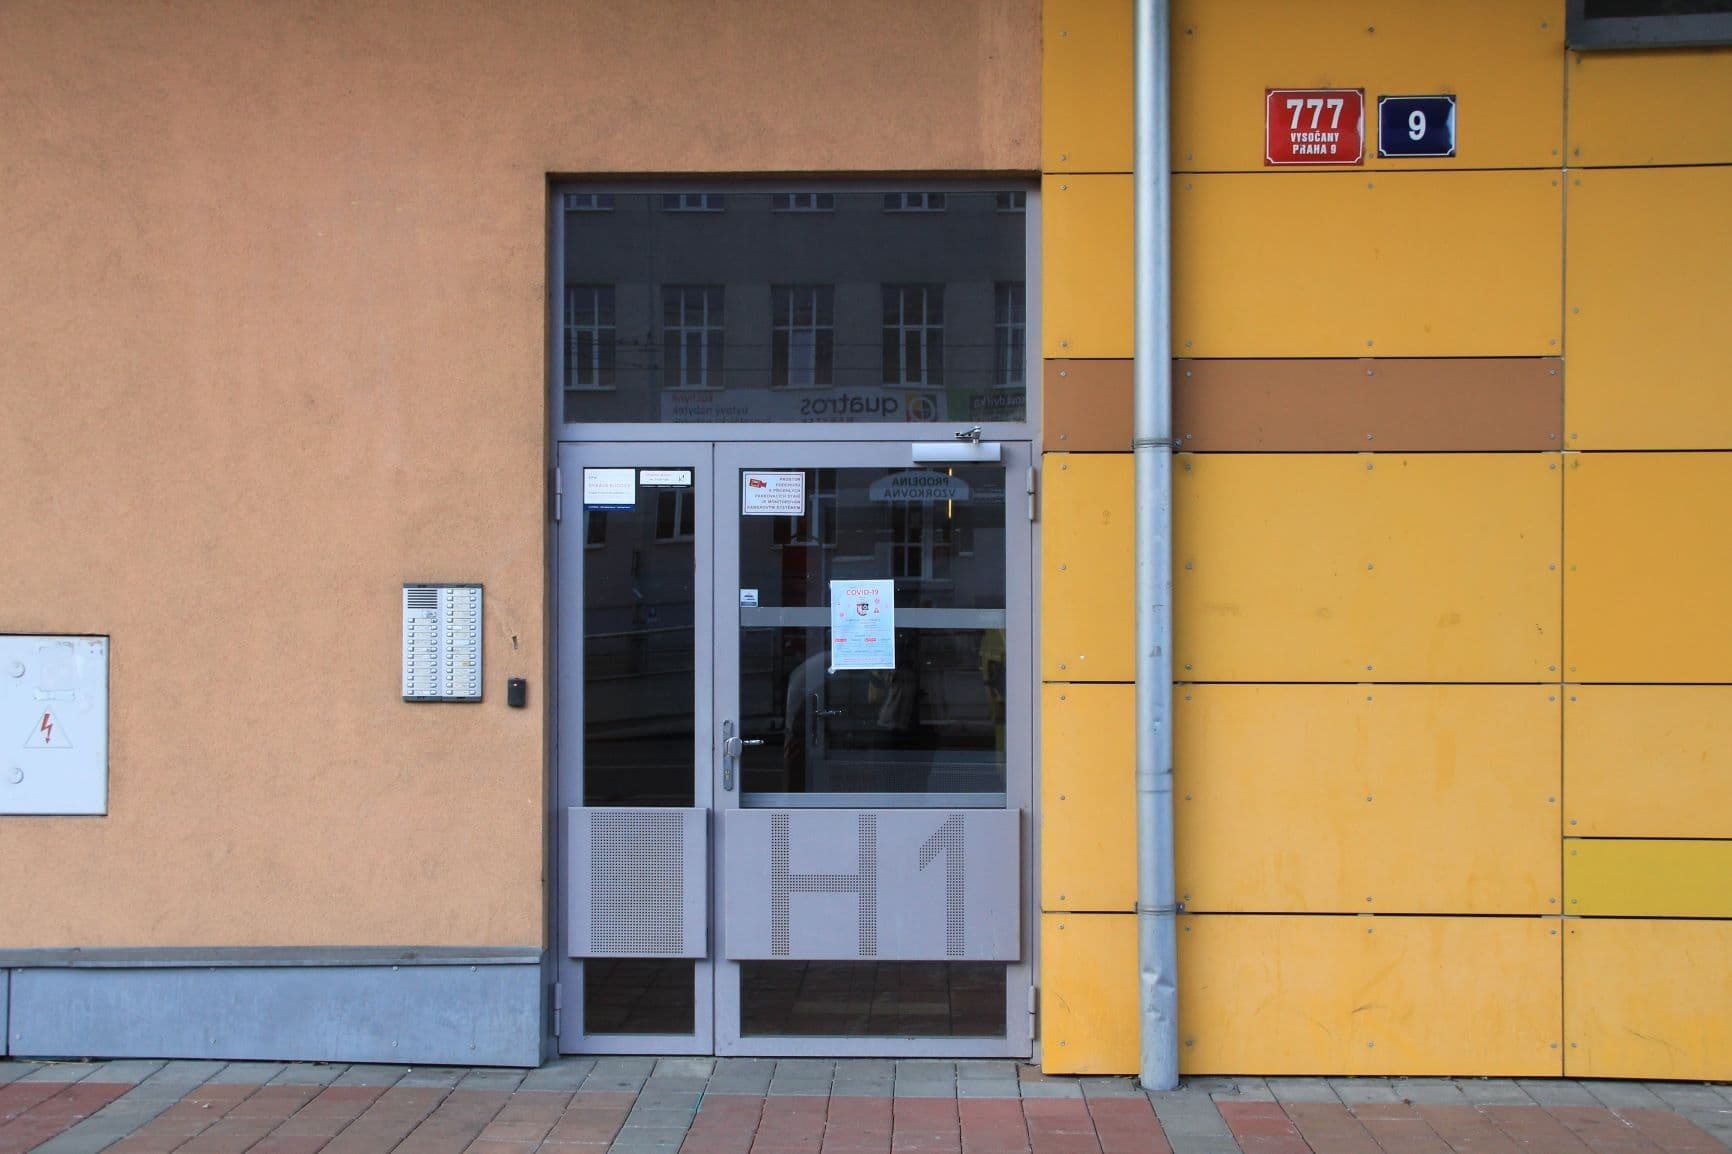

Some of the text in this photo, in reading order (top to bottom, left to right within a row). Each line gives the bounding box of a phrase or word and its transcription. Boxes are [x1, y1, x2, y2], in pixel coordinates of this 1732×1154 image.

[1286, 99, 1344, 130] 777
[1290, 130, 1340, 142] VYSOČANY
[1408, 110, 1426, 141] 9
[1292, 144, 1337, 155] PRAHA 9
[846, 588, 879, 596] COVID-19
[771, 814, 965, 956] H1
